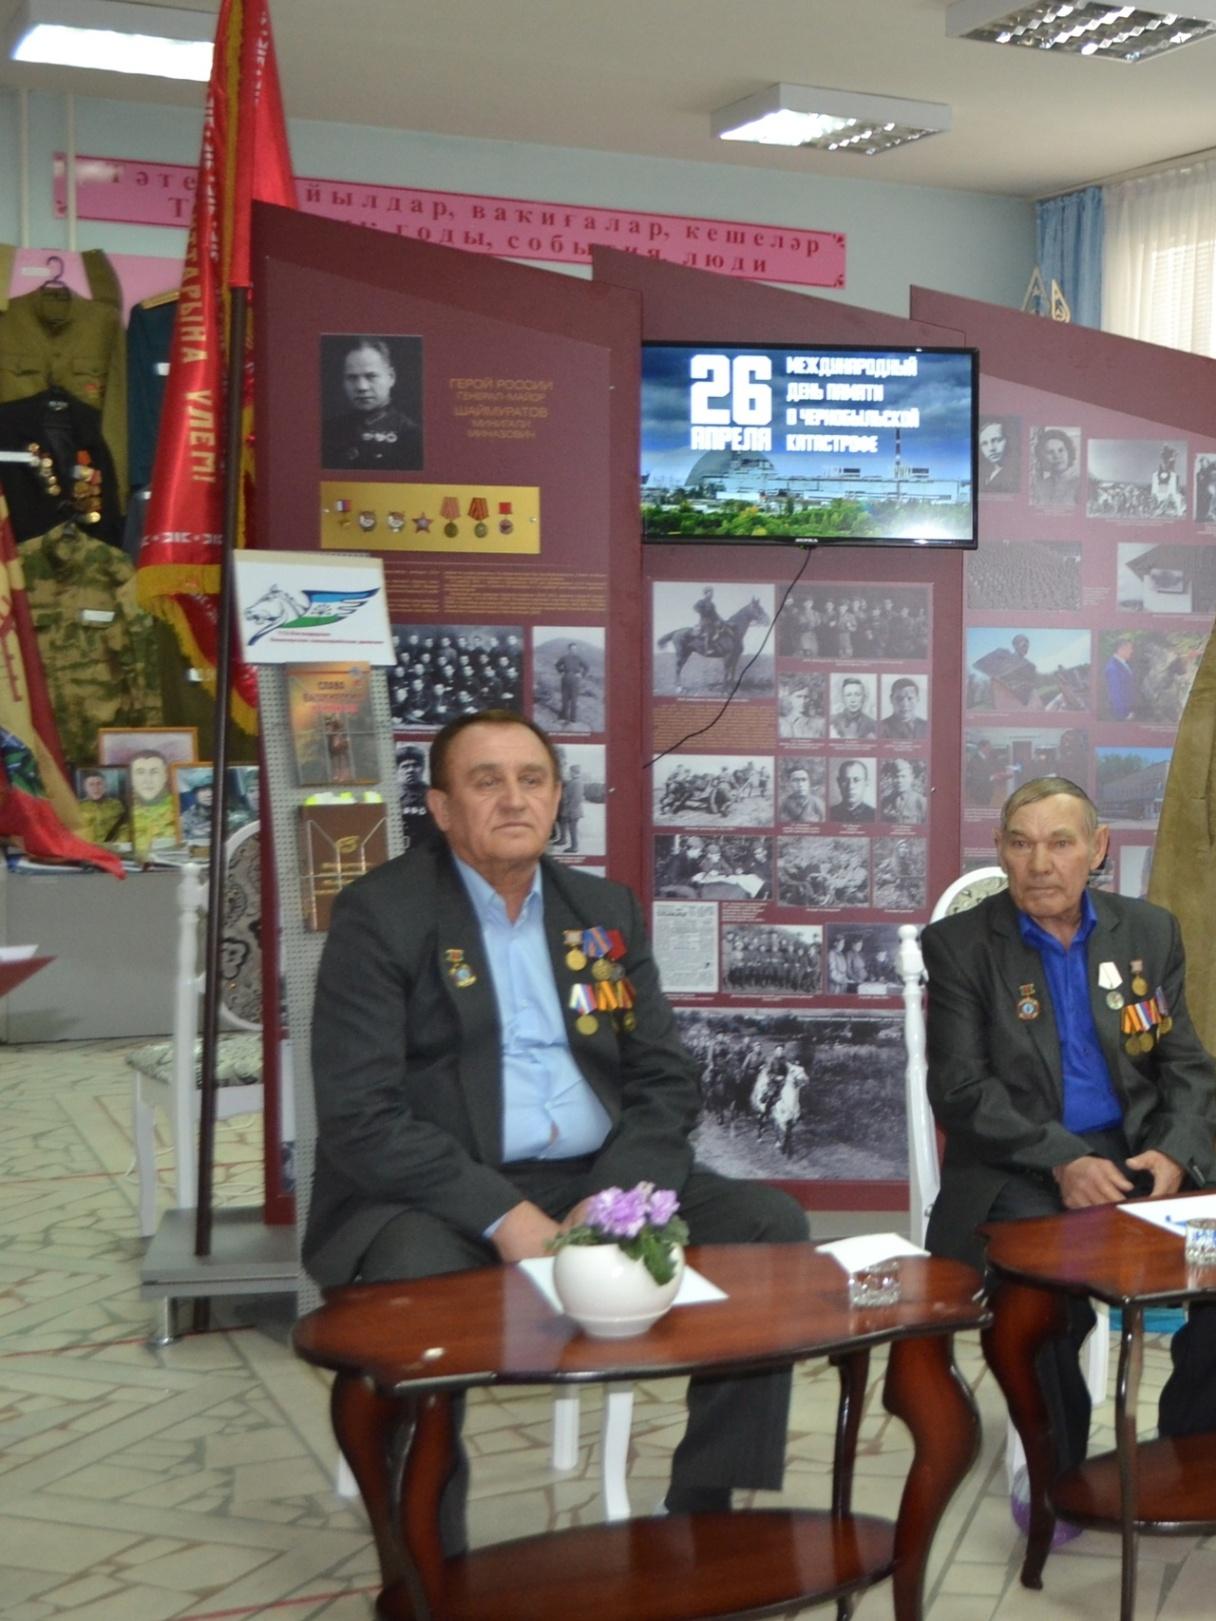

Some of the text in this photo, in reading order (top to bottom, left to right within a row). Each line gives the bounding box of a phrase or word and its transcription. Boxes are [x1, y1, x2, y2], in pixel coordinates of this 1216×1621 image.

[306, 184, 455, 220] йылдар,
[472, 203, 670, 241] ваҡиғалар,
[685, 224, 819, 256] кешеләр
[682, 250, 767, 273] люди
[690, 354, 918, 425] 26 МЕЖДУНАРОДНЫЙ
[786, 382, 884, 402] ДЕНЬ ПАМЯТИ
[799, 407, 920, 428] ЧЕРНОБЫЛЬСКОЙ
[691, 426, 879, 453] АПРЕЛЯ КАТАСТРОФЕ
